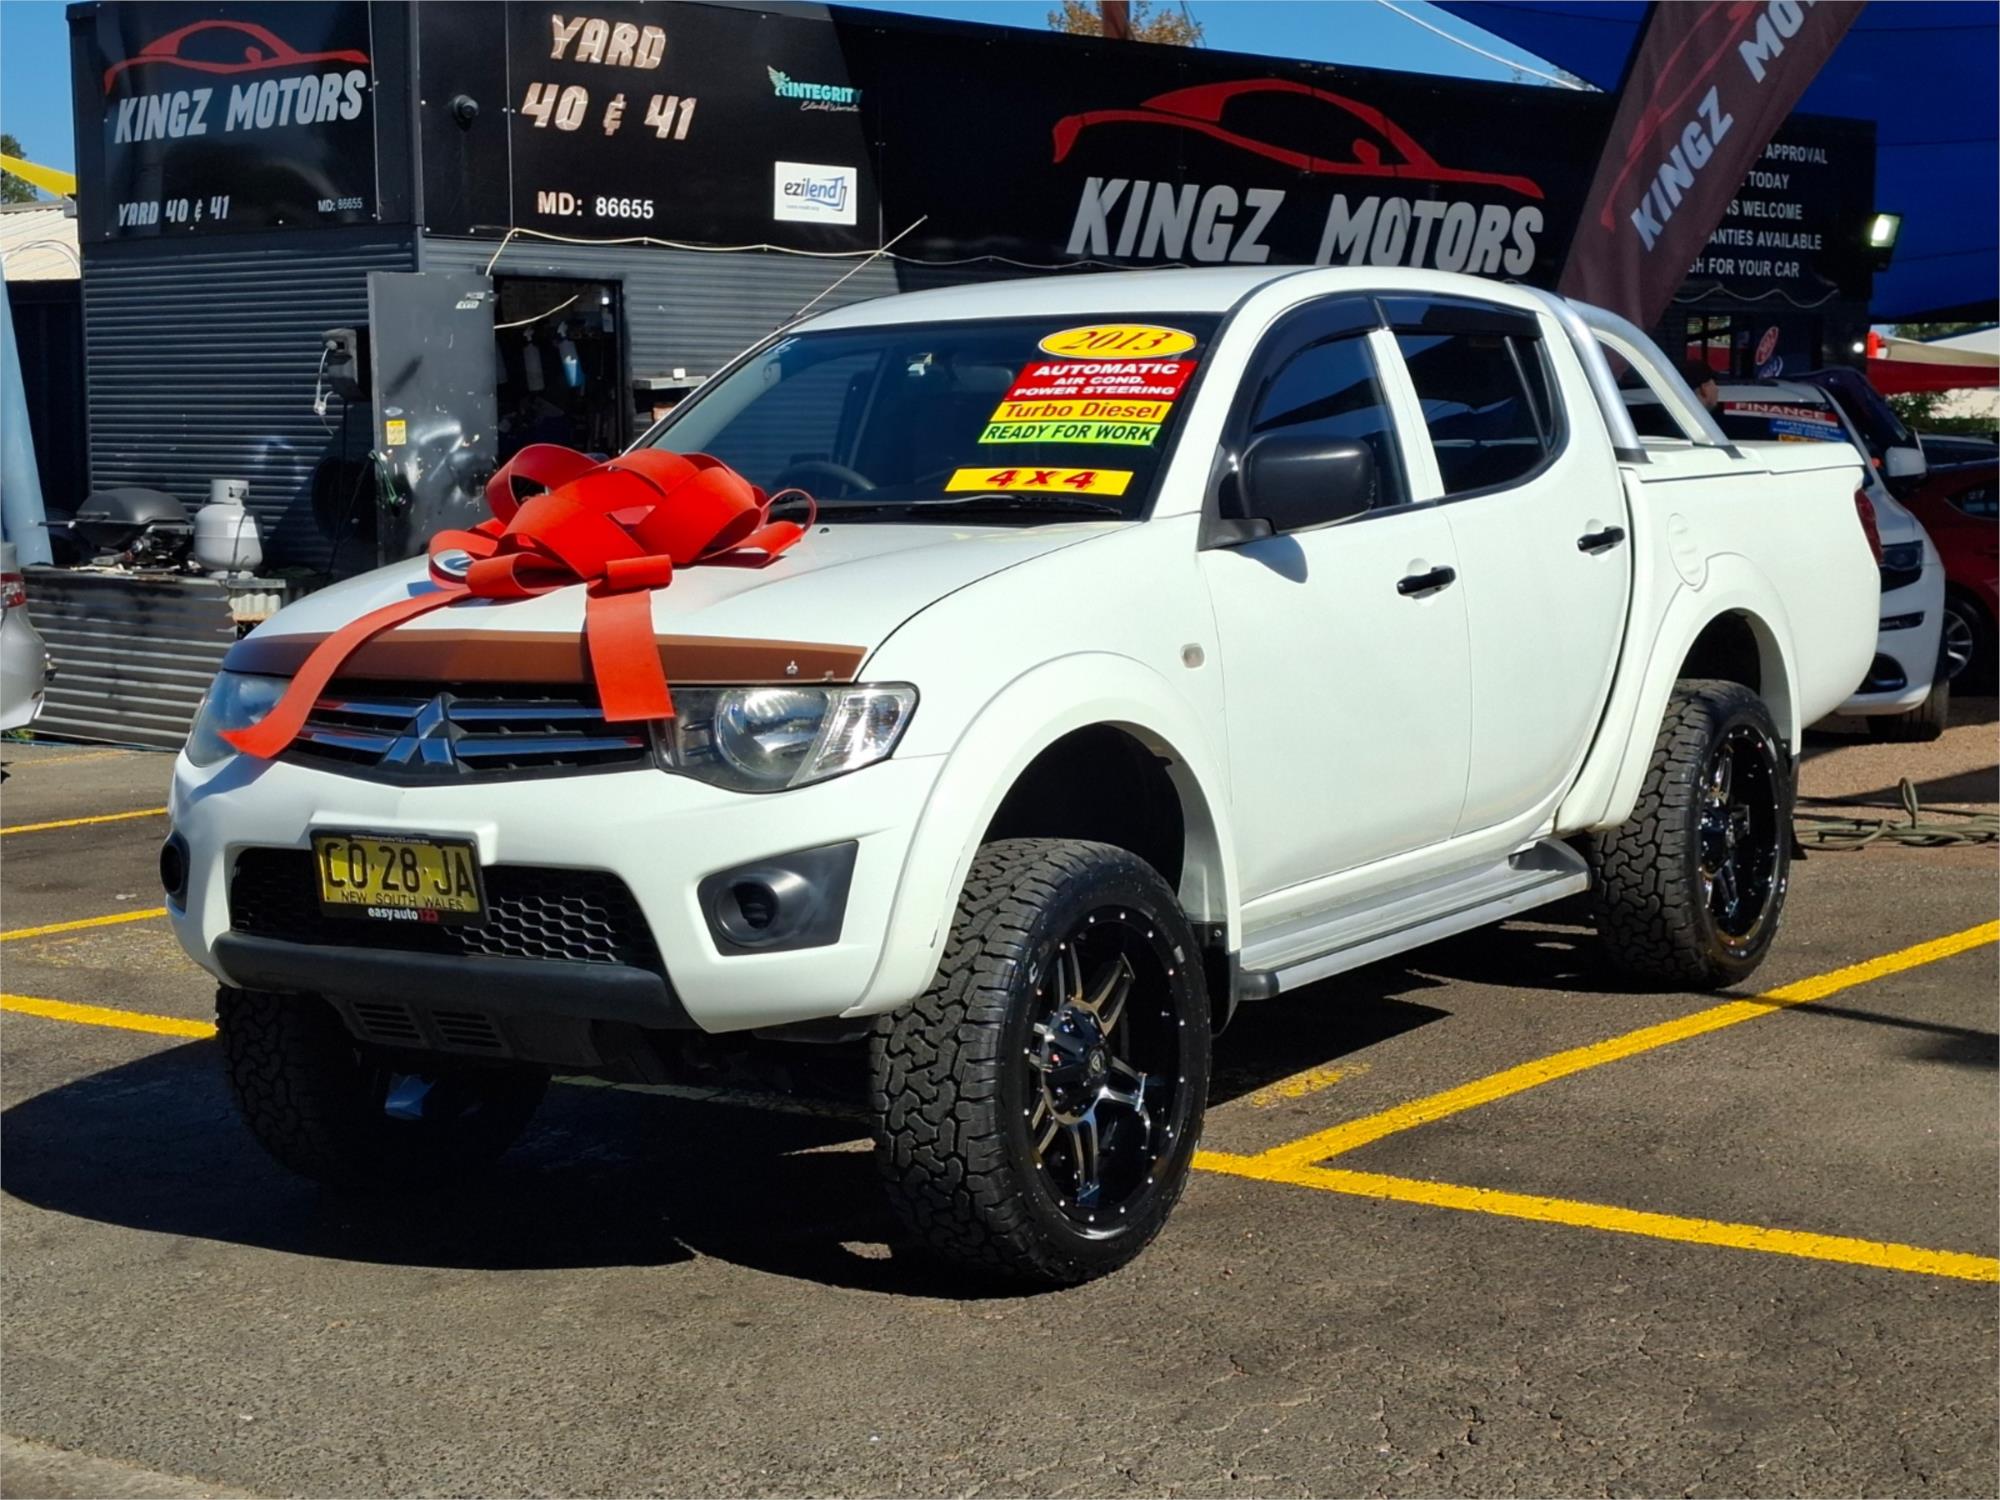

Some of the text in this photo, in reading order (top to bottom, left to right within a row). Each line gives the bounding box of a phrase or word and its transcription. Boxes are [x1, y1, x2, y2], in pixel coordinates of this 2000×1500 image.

[550, 14, 666, 70] YARD
[114, 70, 367, 144] KINGZ MOTORS
[521, 82, 588, 131] 40
[644, 94, 697, 140] 41
[1630, 0, 1816, 252] KINGZ MO
[1765, 143, 1828, 164] APPROVAL
[784, 178, 839, 199] ezilend
[1748, 171, 1790, 189] TODAY
[118, 201, 159, 226] YARD
[165, 199, 188, 223] 40
[210, 195, 230, 220] 41
[318, 199, 336, 213] MD:
[537, 190, 654, 219] MD: 86655
[1742, 200, 1803, 220] WELCOME
[1066, 177, 1545, 276] KINGZ MOTORS
[1757, 231, 1822, 250] AVAILABLE
[1708, 257, 1735, 275] FOR
[1738, 259, 1772, 276] YOUR
[1774, 261, 1800, 278] CAR
[1058, 331, 1173, 351] 2013
[1033, 363, 1180, 377] AUTOMATIC
[1053, 375, 1146, 386] AIR COND.
[1013, 386, 1176, 397] POWER STEERING
[1005, 402, 1162, 419] Turbo Diesel
[1735, 402, 1826, 419] FINANCE
[985, 424, 1157, 442] READY FOR WORK
[341, 891, 465, 911] NEW SOUTH WALES
